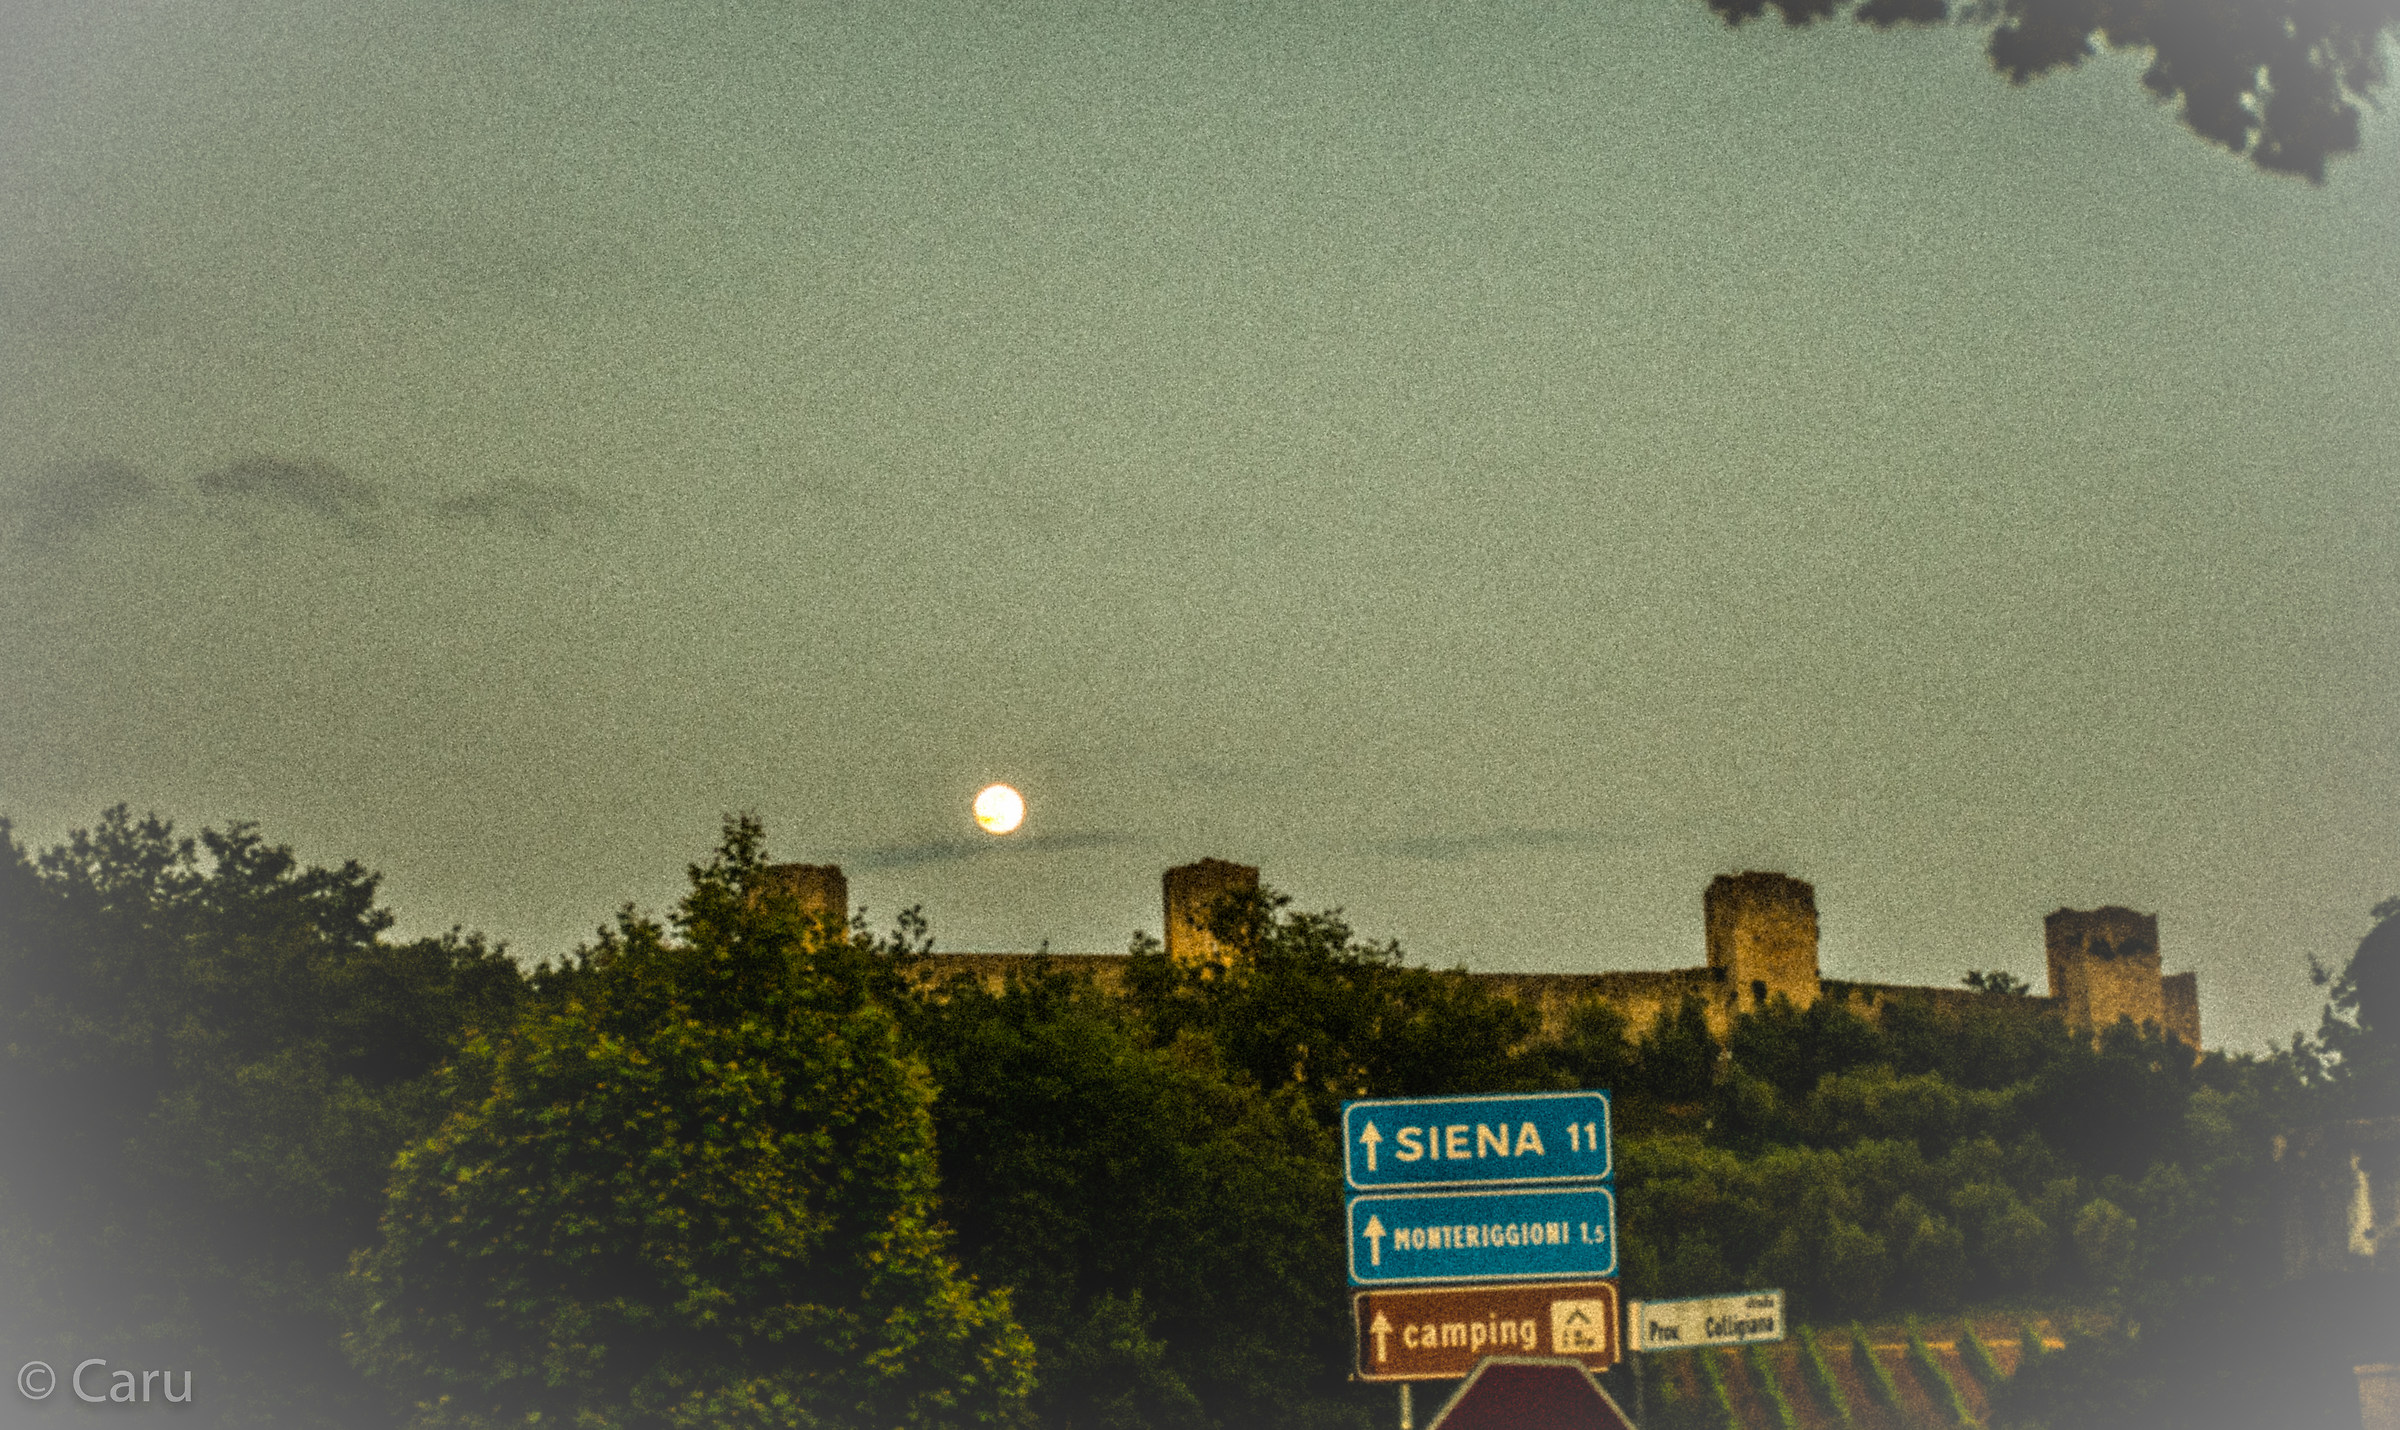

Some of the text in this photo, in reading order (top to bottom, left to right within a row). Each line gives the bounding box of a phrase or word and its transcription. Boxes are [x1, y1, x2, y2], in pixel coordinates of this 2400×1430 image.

[1395, 1121, 1598, 1162] SIENA 11
[1394, 1221, 1570, 1251] MONTERIGGIONI
[1403, 1312, 1538, 1352] camping
